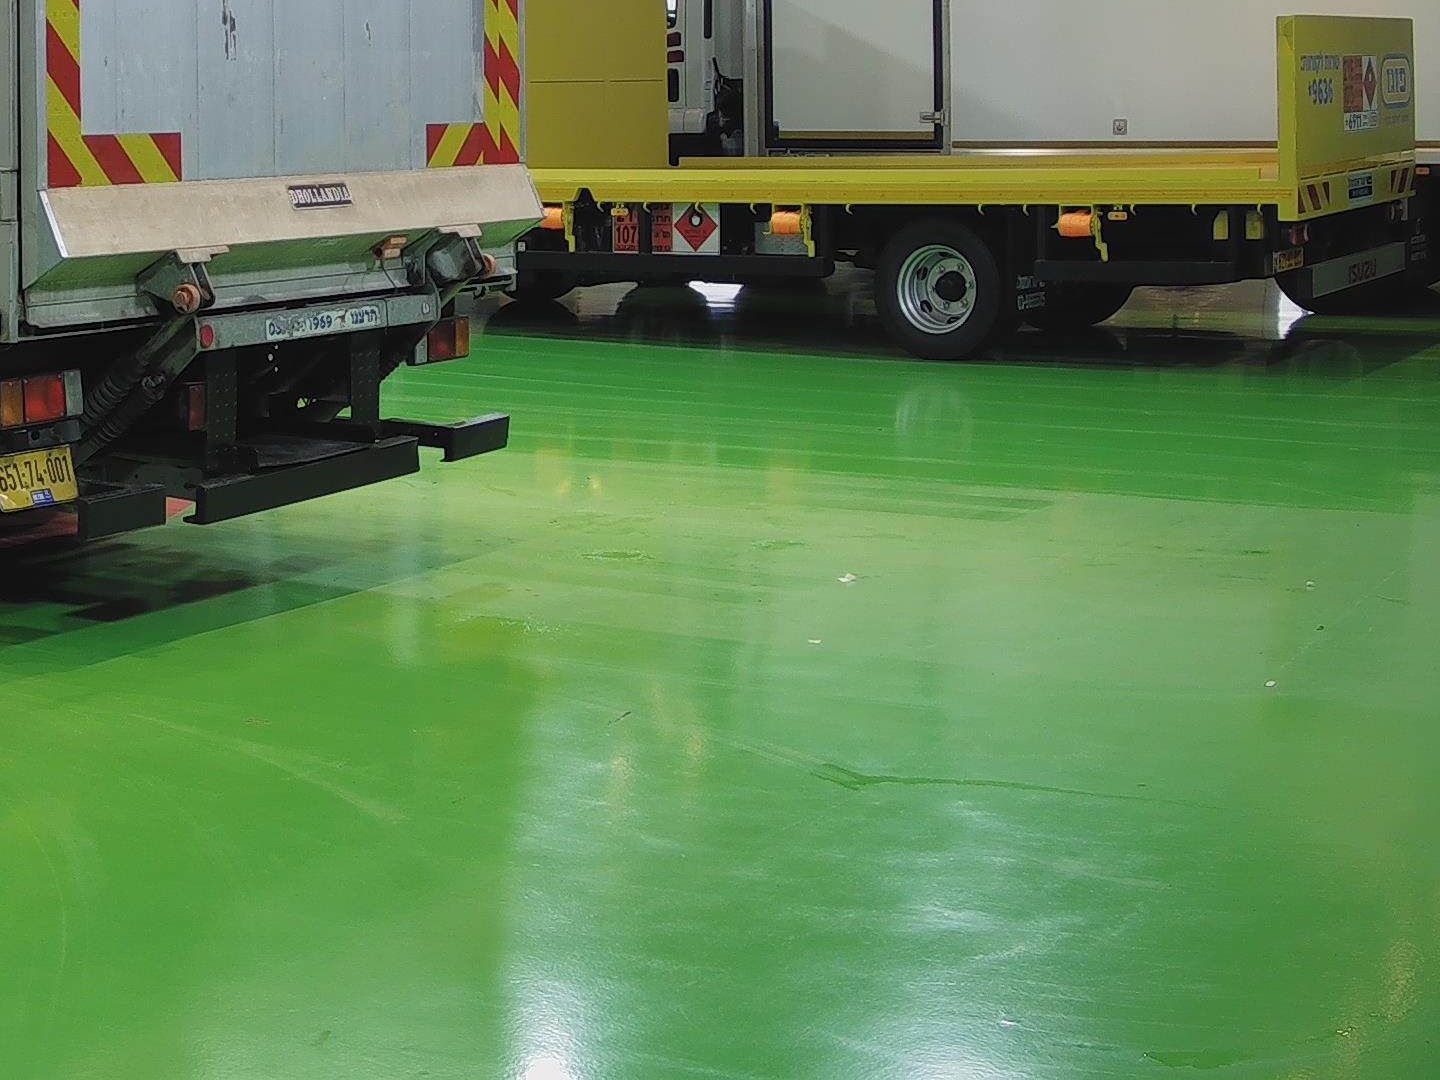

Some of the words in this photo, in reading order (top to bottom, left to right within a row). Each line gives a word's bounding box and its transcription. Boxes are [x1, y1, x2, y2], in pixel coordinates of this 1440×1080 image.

[288, 186, 352, 204] DHOLLANDIA
[616, 225, 637, 243] 107
[1347, 258, 1377, 284] ISUZU
